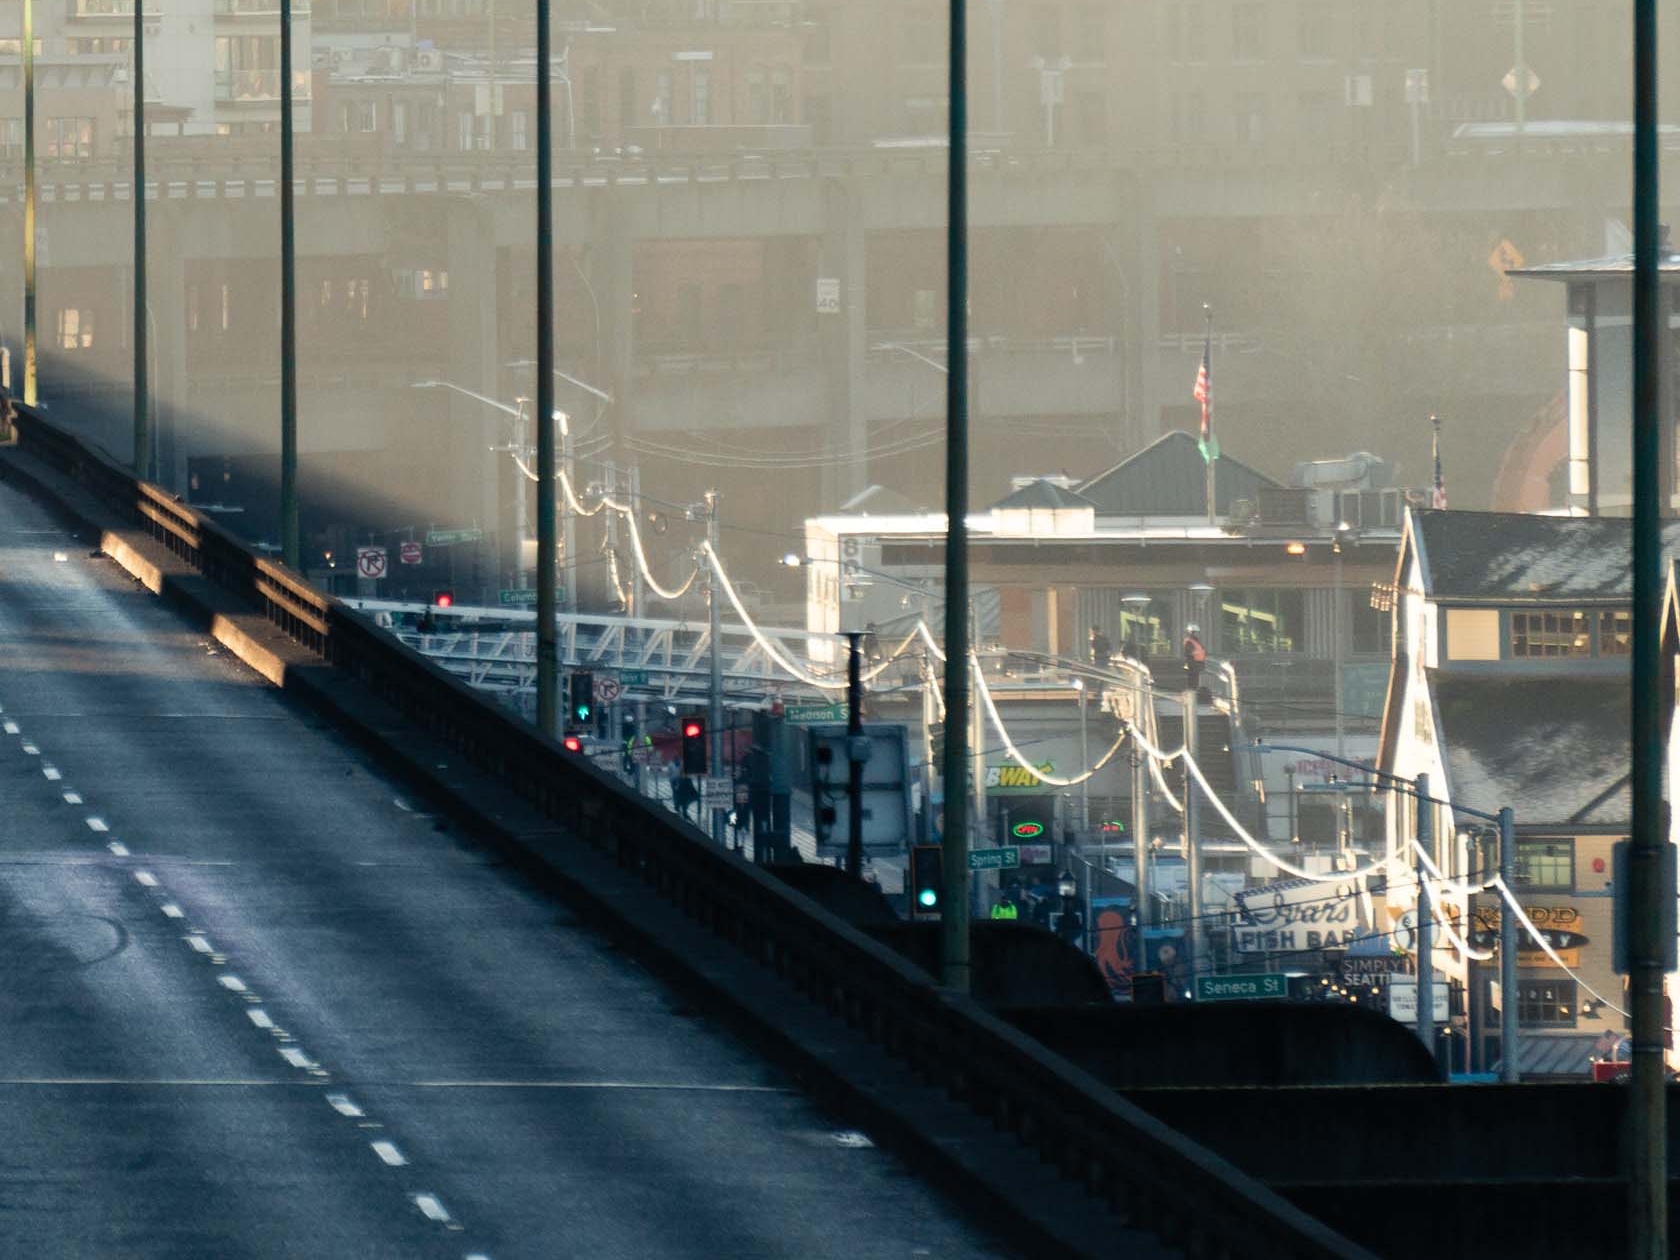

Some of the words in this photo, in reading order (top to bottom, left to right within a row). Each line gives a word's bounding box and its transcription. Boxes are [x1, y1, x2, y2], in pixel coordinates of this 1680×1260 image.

[819, 297, 839, 309] 40
[970, 853, 1002, 867] Spring
[1005, 850, 1016, 864] St
[1343, 959, 1401, 974] SIMPLY
[1204, 981, 1257, 995] Seneca
[1263, 978, 1279, 992] St
